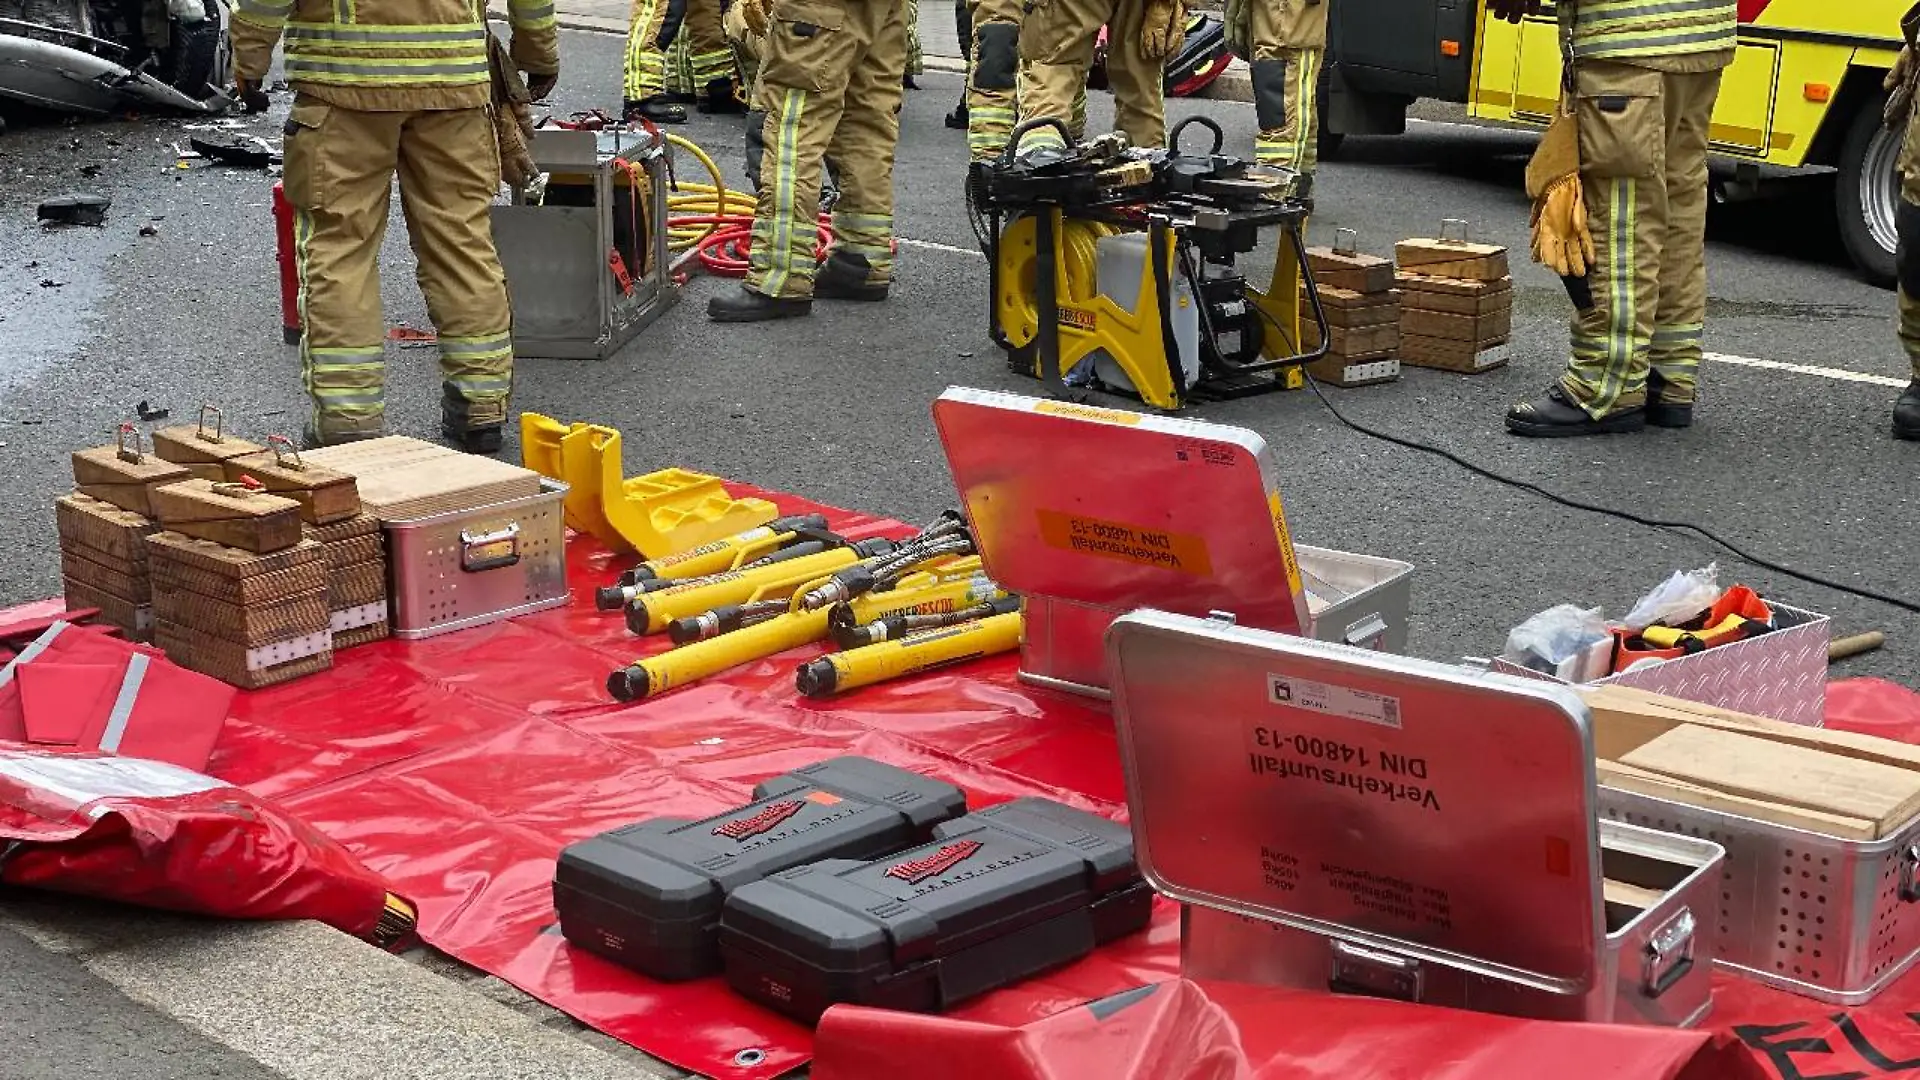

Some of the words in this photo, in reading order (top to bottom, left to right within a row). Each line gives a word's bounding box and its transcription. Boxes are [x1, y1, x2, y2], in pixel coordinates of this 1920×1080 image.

[1071, 520, 1135, 541] 14800-13
[1141, 532, 1169, 548] DIN
[1070, 536, 1179, 567] Verkehrsunfall
[1254, 727, 1369, 766] 14800-13
[1380, 751, 1426, 779] DIN
[1250, 753, 1441, 811] Verkehrsunfall
